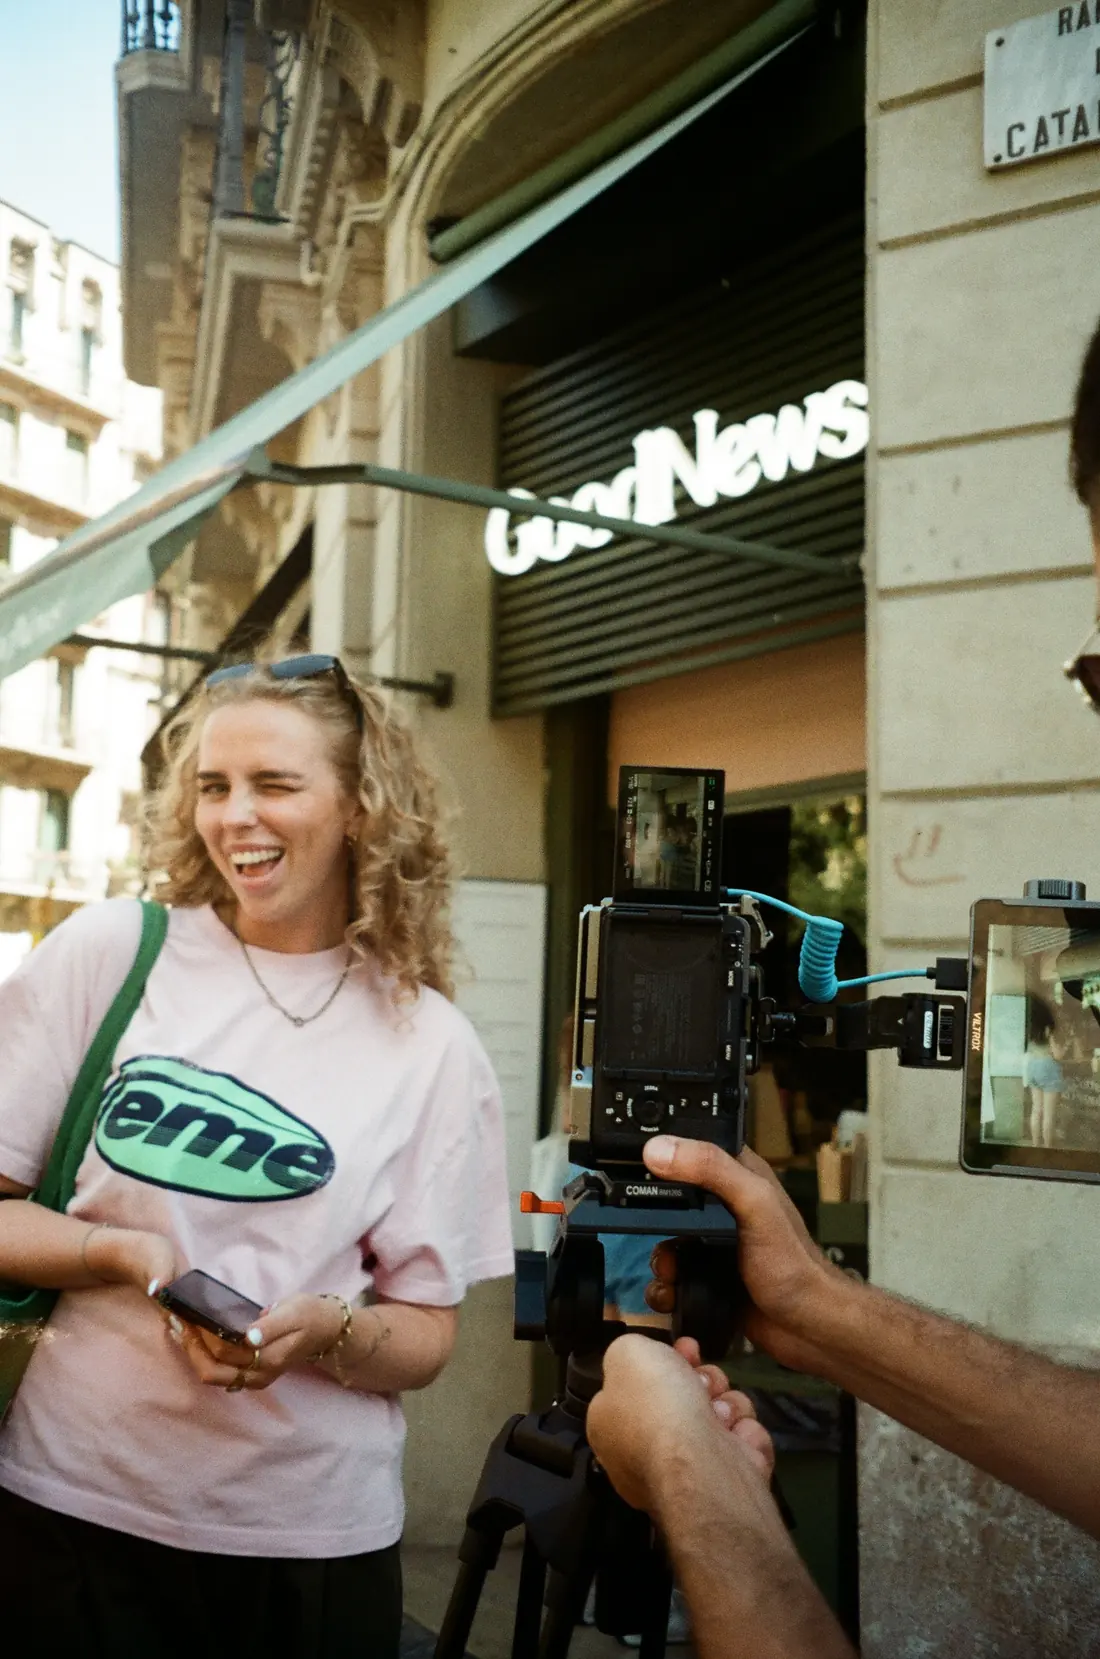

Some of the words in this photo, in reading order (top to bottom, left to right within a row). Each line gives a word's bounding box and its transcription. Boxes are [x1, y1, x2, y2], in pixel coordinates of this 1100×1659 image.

[1006, 100, 1100, 158] CATA
[971, 1012, 982, 1052] VILTROX
[724, 1044, 732, 1061] MENU
[625, 1185, 658, 1196] COMAN
